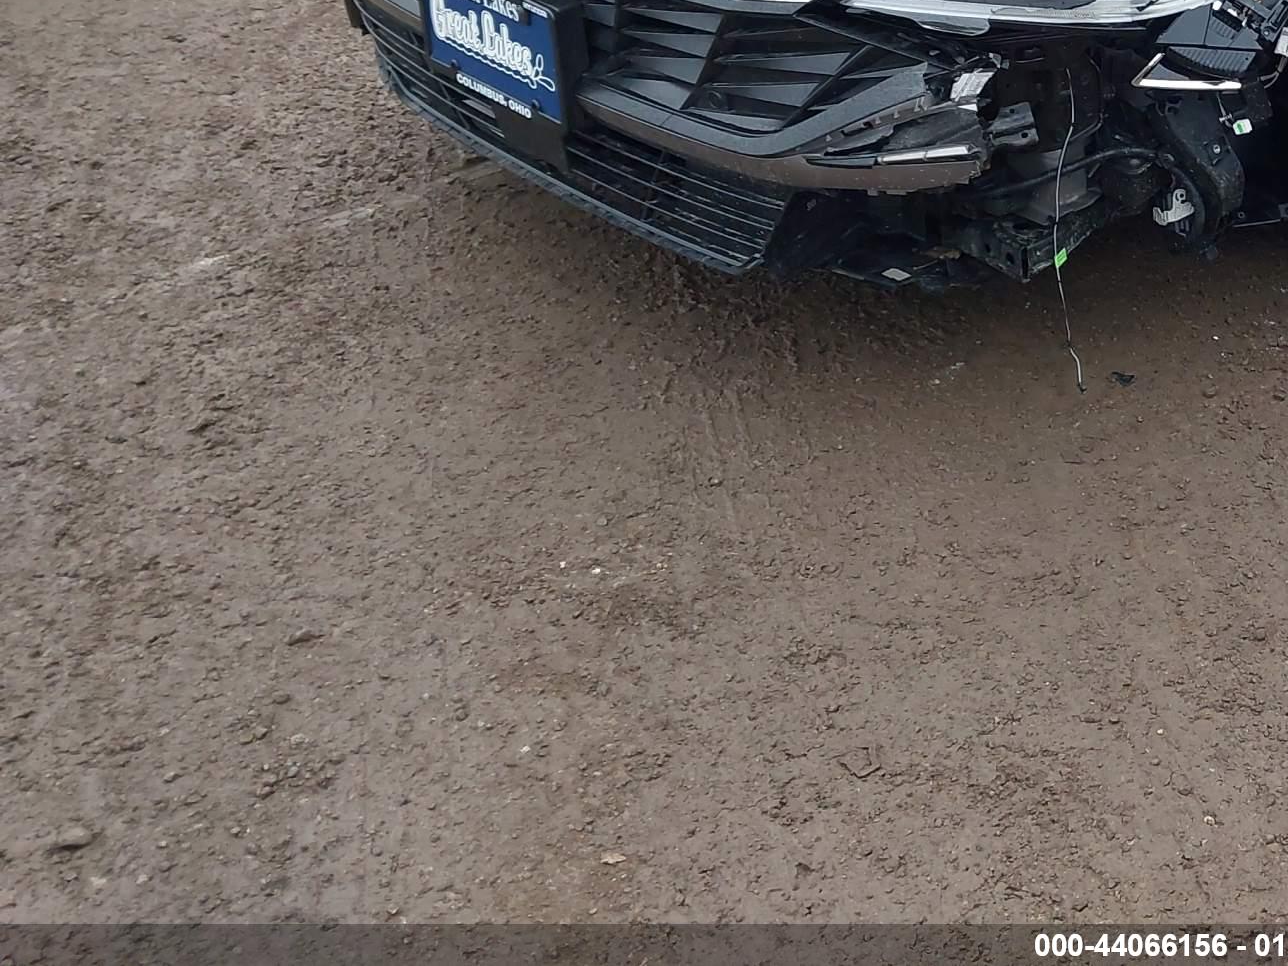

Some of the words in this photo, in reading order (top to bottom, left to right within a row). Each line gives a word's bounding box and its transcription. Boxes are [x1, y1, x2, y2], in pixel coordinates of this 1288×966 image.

[480, 10, 533, 76] Lakes
[456, 74, 508, 107] COLUMBUS,
[508, 100, 532, 119] OHIO
